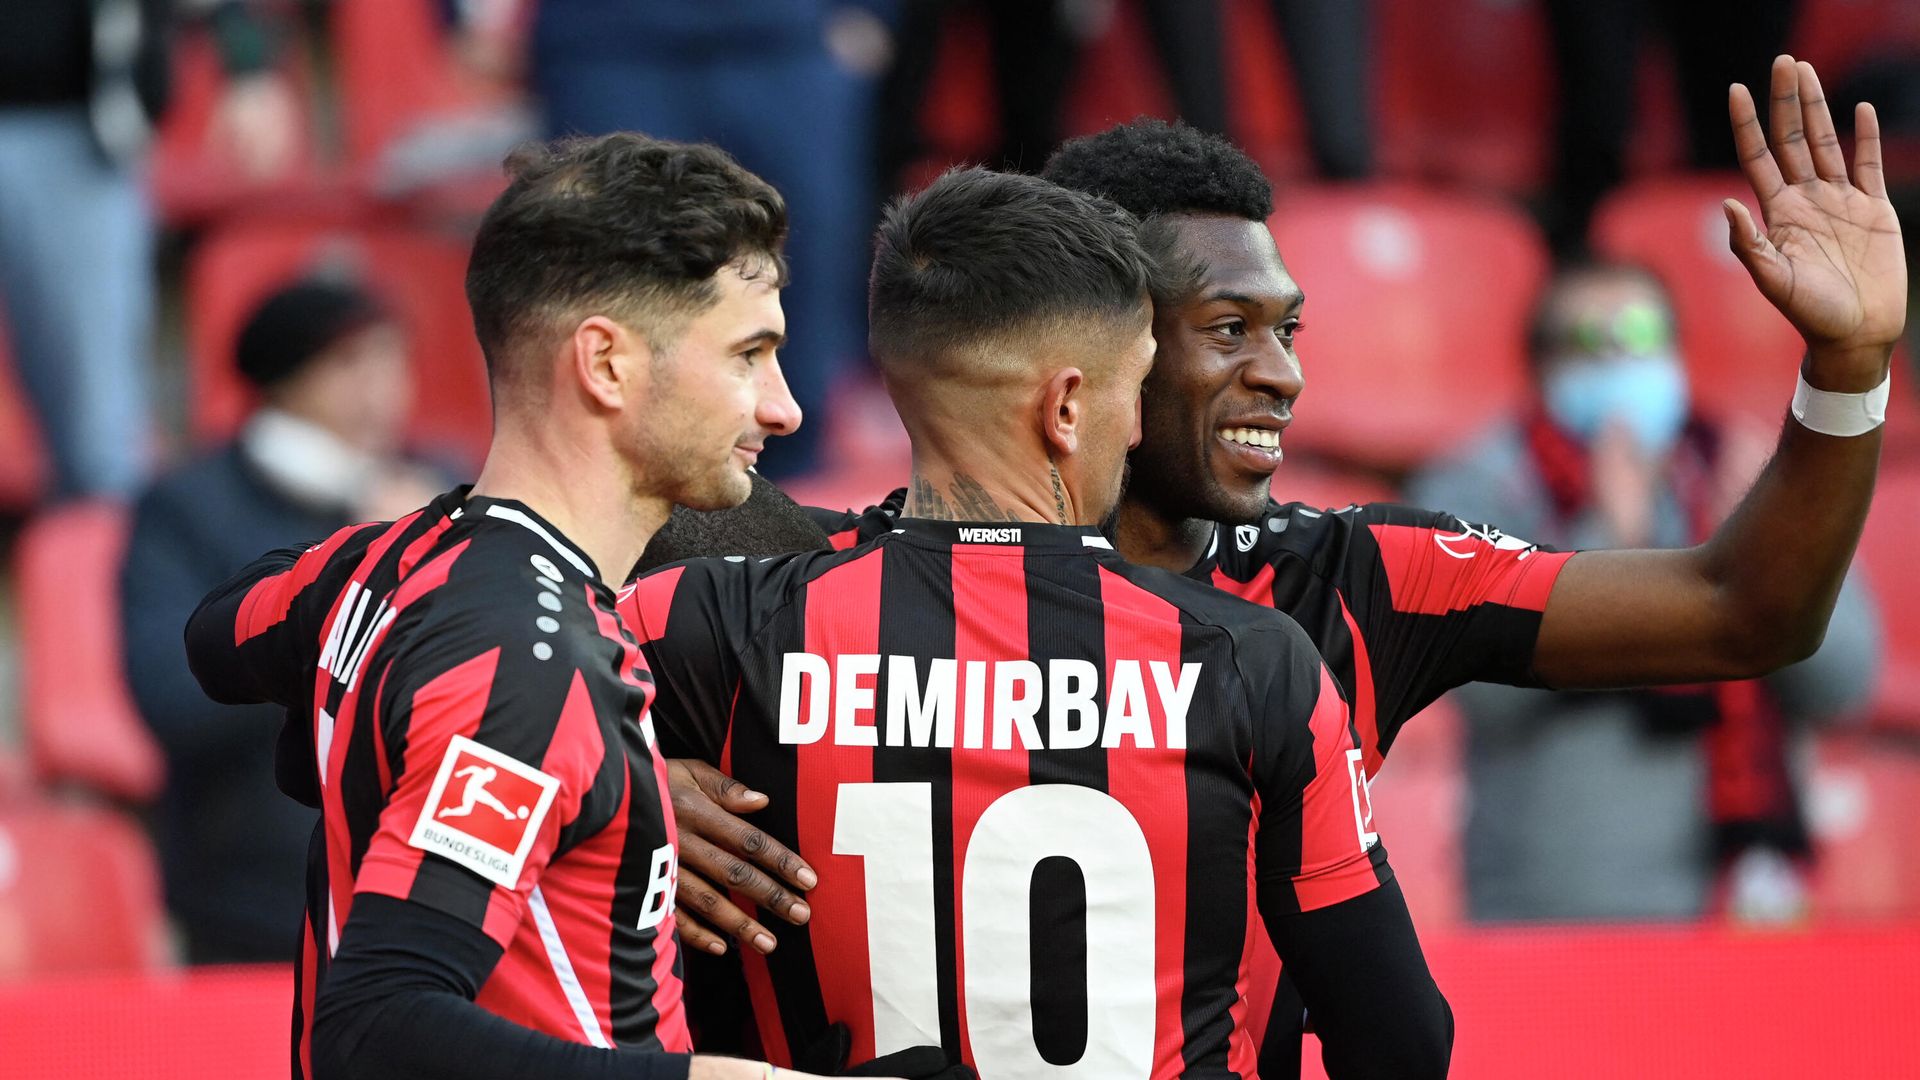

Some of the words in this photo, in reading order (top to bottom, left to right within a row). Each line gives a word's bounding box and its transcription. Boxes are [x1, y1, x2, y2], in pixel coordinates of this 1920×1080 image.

[958, 528, 1022, 543] WERKS11
[778, 652, 1203, 750] DEMIRBAY
[423, 828, 509, 874] BUNDESLIGA
[636, 842, 679, 931] B
[831, 782, 1156, 1080] 10
